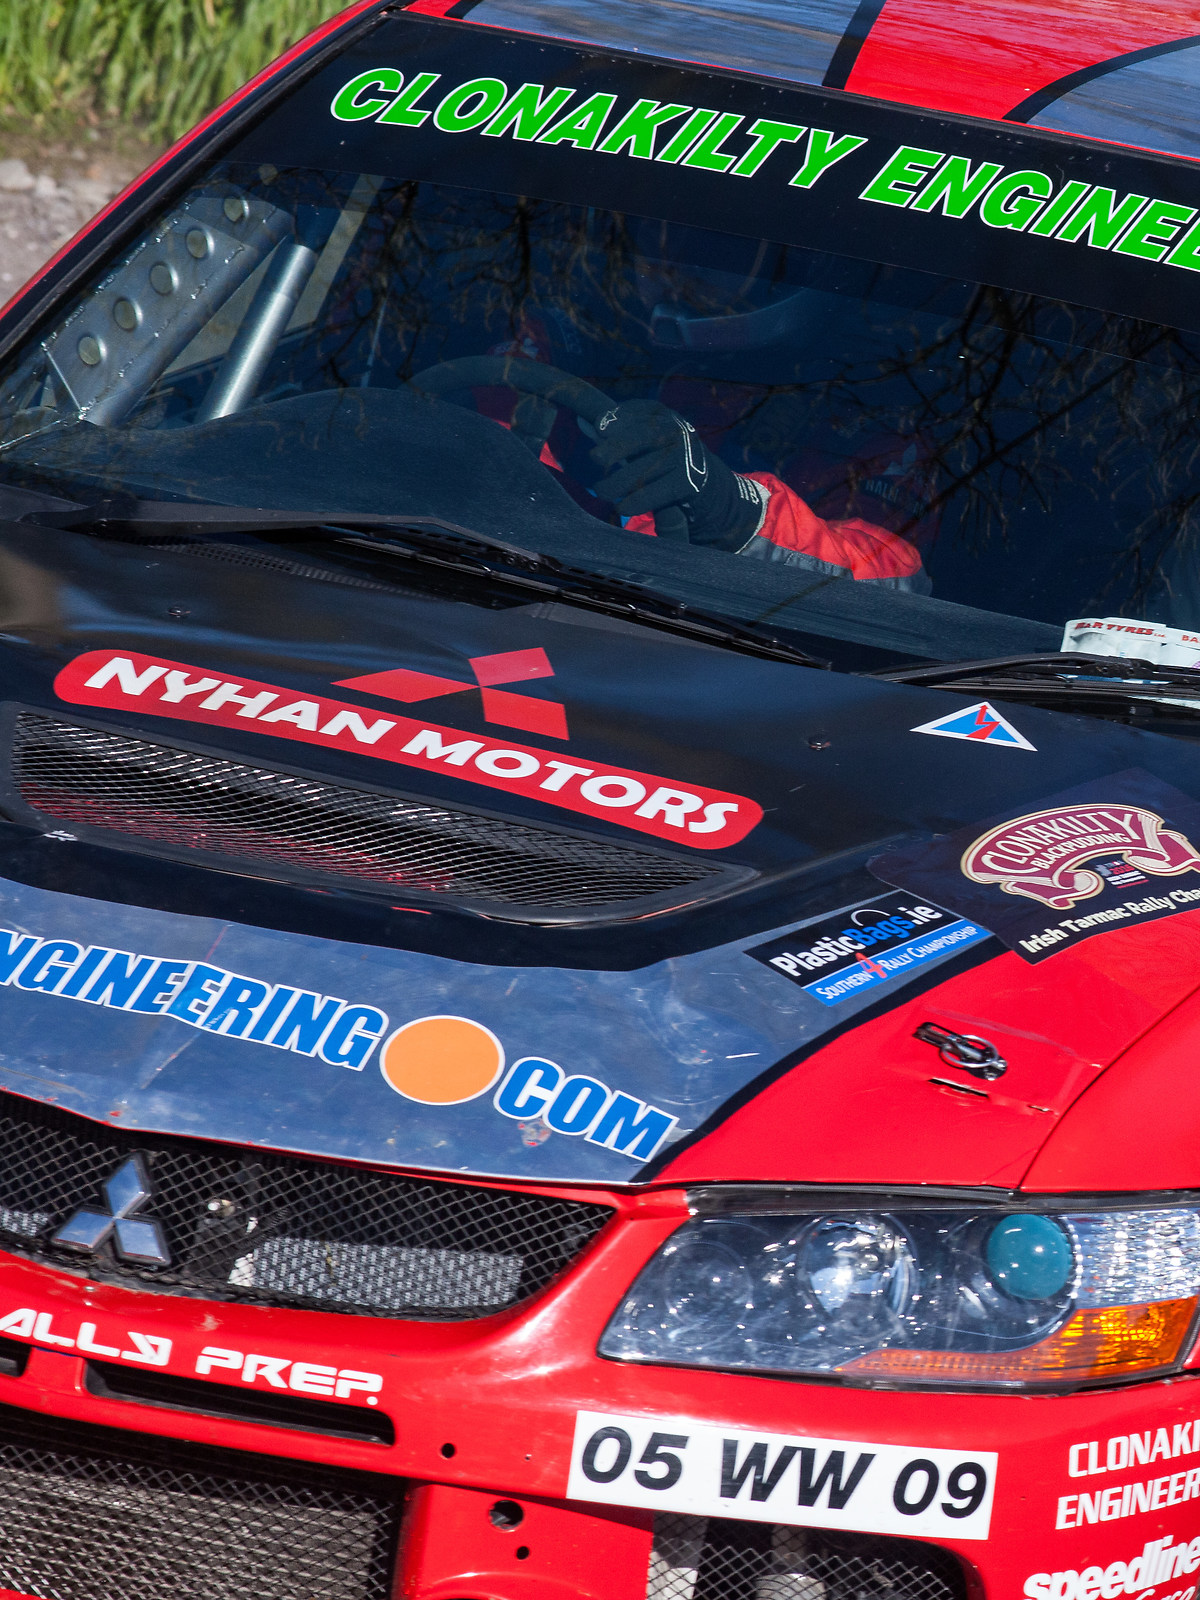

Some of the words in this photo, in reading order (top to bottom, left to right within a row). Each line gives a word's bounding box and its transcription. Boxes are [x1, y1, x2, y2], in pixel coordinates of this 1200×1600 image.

[330, 67, 869, 190] CLONAKILTY
[1107, 624, 1155, 636] TYRES
[84, 656, 398, 746] NYHAN
[400, 729, 740, 834] MOTORS
[981, 812, 1142, 875] CLONAKILTY
[1029, 832, 1133, 870] BLACKPUDDING
[769, 905, 943, 977] PlasticBags.ie
[1019, 925, 1065, 953] Irish
[1066, 906, 1131, 936] Tarmac
[1128, 896, 1171, 926] Rally
[195, 1346, 384, 1406] PREP.
[580, 1426, 689, 1491] 05
[719, 1438, 876, 1510] WW
[891, 1458, 987, 1519] 09
